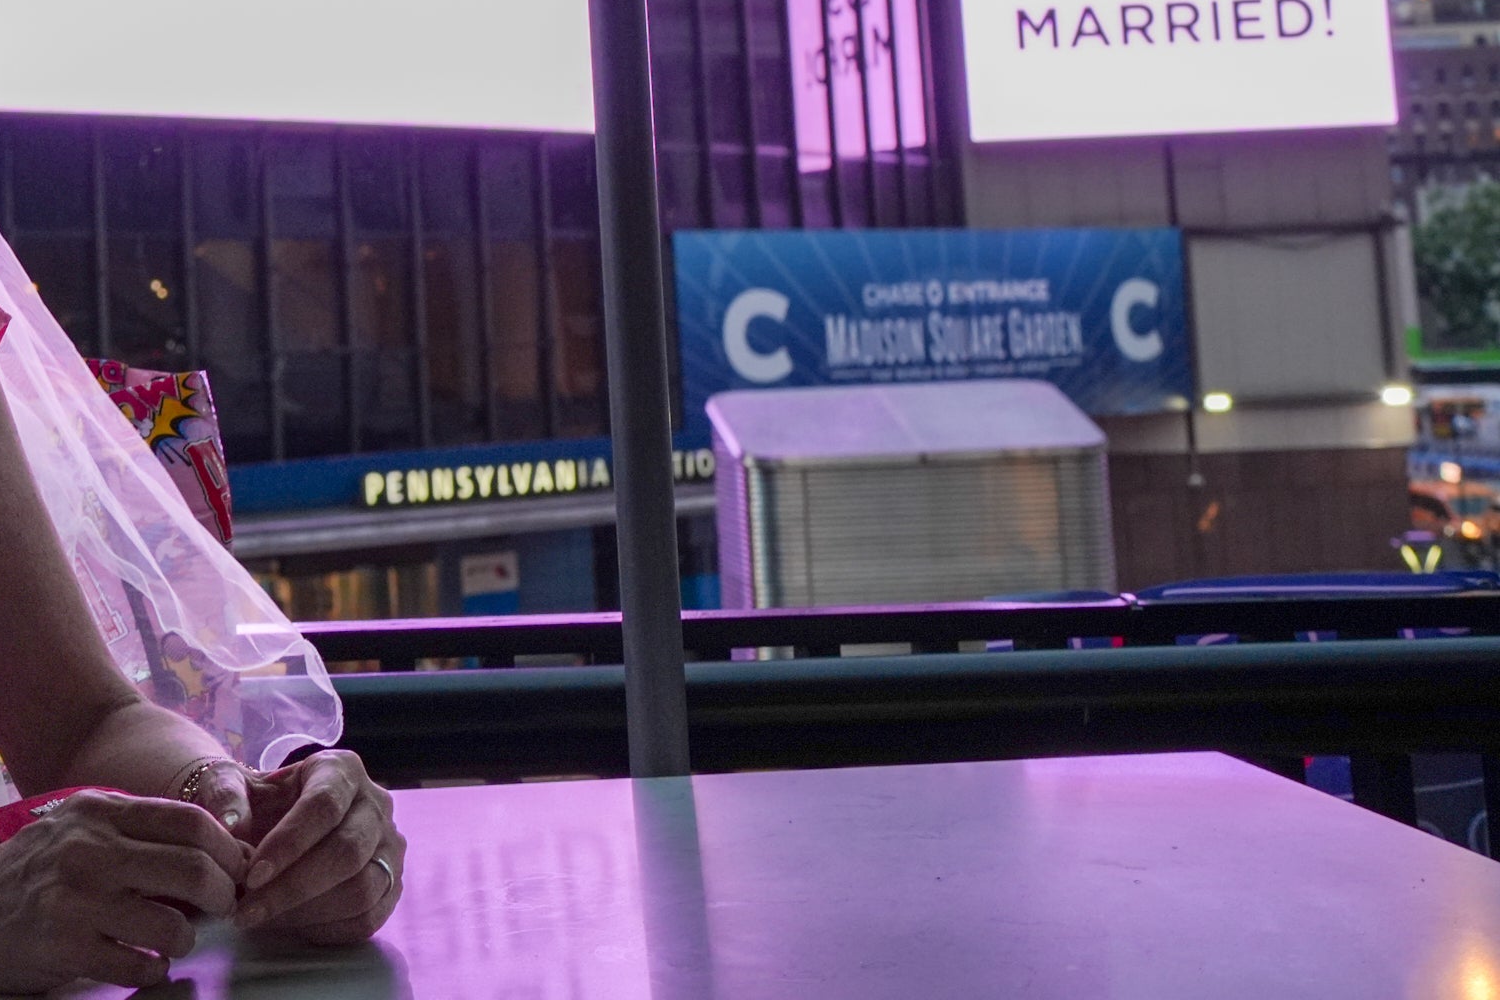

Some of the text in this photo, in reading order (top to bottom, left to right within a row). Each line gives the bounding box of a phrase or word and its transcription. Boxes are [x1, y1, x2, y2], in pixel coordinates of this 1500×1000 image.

[948, 278, 1049, 304] ENTRANCE
[1110, 277, 1165, 362] C
[723, 287, 793, 384] C
[364, 457, 611, 507] PENNSYLVANIA
